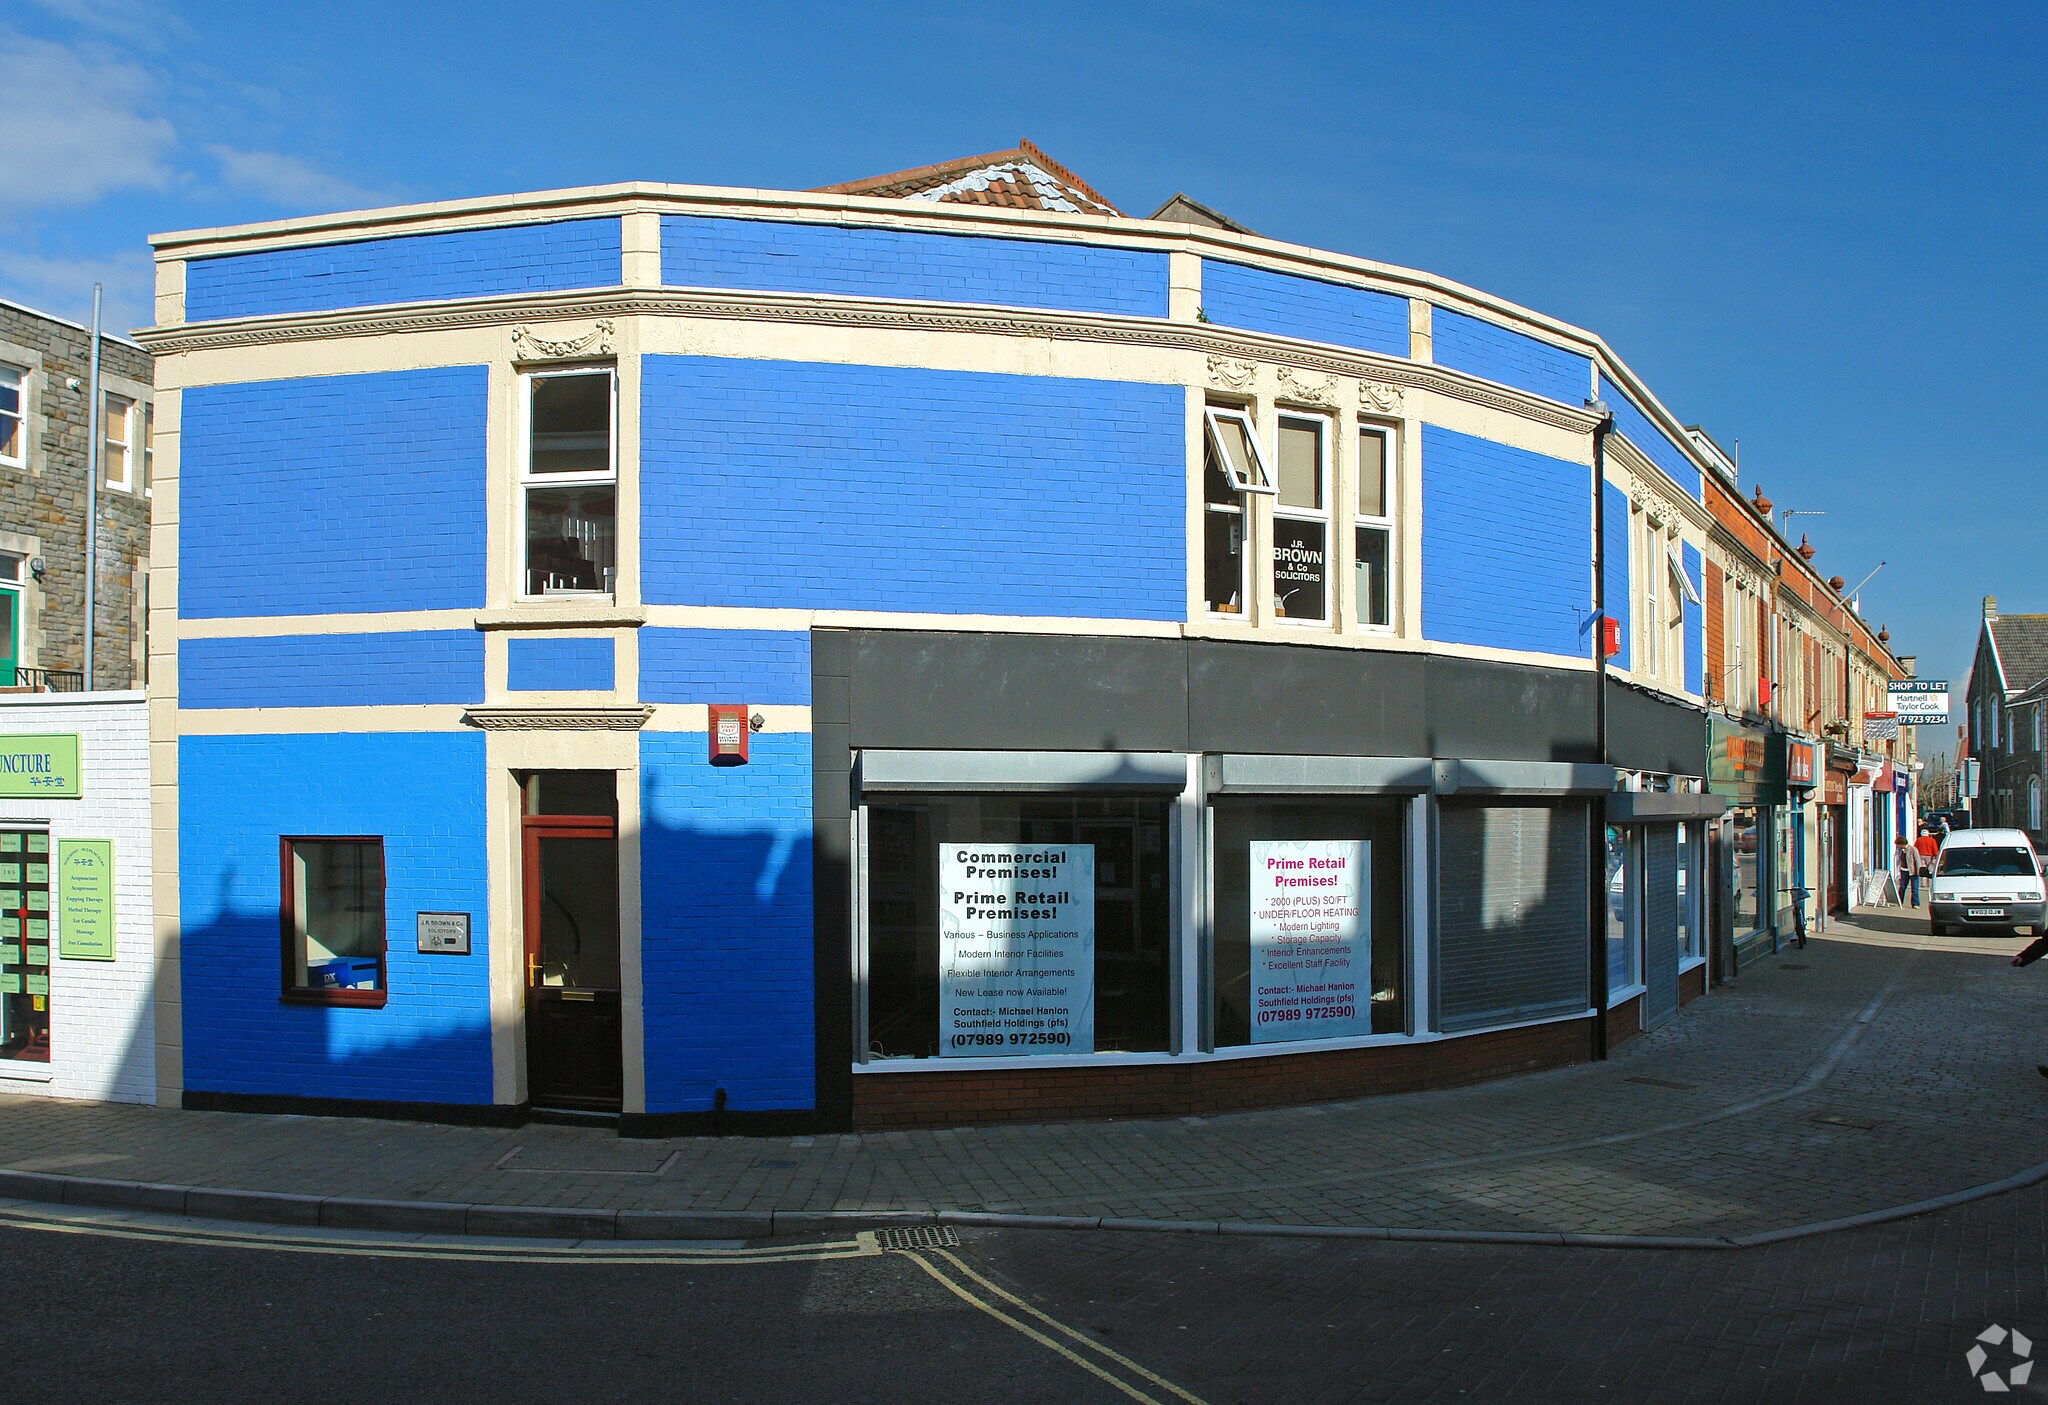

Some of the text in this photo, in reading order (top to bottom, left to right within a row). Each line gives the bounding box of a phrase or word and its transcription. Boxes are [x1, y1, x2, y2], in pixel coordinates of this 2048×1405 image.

[1290, 540, 1304, 548] J.R.
[1273, 548, 1322, 564] BROWN
[1275, 570, 1320, 582] SOLICITORS
[1896, 703, 1918, 711] Taylor
[1909, 715, 1924, 723] 923
[1925, 715, 1946, 723] 9234
[956, 850, 1066, 863] Commercial
[1267, 858, 1345, 869] Prime Retail
[967, 866, 1057, 878] Premises!
[1275, 875, 1338, 887] Premises!
[954, 891, 1068, 904] Prime Retail
[1271, 896, 1347, 907] 2000 (PLUS) SQ/FT
[967, 906, 1057, 919] Premises!
[1259, 908, 1359, 919] UNDER/FLOOR HEATING
[1280, 922, 1339, 932] Modern Lighting
[1028, 930, 1079, 940] Applications
[1277, 934, 1342, 945] Storage Capacity
[959, 949, 1064, 958] Modern Interior Facilities
[1268, 946, 1351, 957] Interior Enhancements
[1268, 958, 1350, 970] Excellent Staff Facility
[324, 973, 335, 981] DX
[947, 969, 1075, 979] Flexible Interior Arrangements
[1026, 988, 1066, 996] Available!
[1258, 982, 1354, 995] Contact:- Michael Hanlon
[1259, 998, 1298, 1007] Southfield
[1301, 996, 1334, 1005] Holdings
[954, 1006, 1068, 1016] Contact:- Michael Hanlon
[1257, 1006, 1355, 1025] (07989 972590)
[954, 1019, 1001, 1028] Southfield
[1004, 1019, 1044, 1030] Holdings
[951, 1032, 1070, 1048] (07989 972590)
